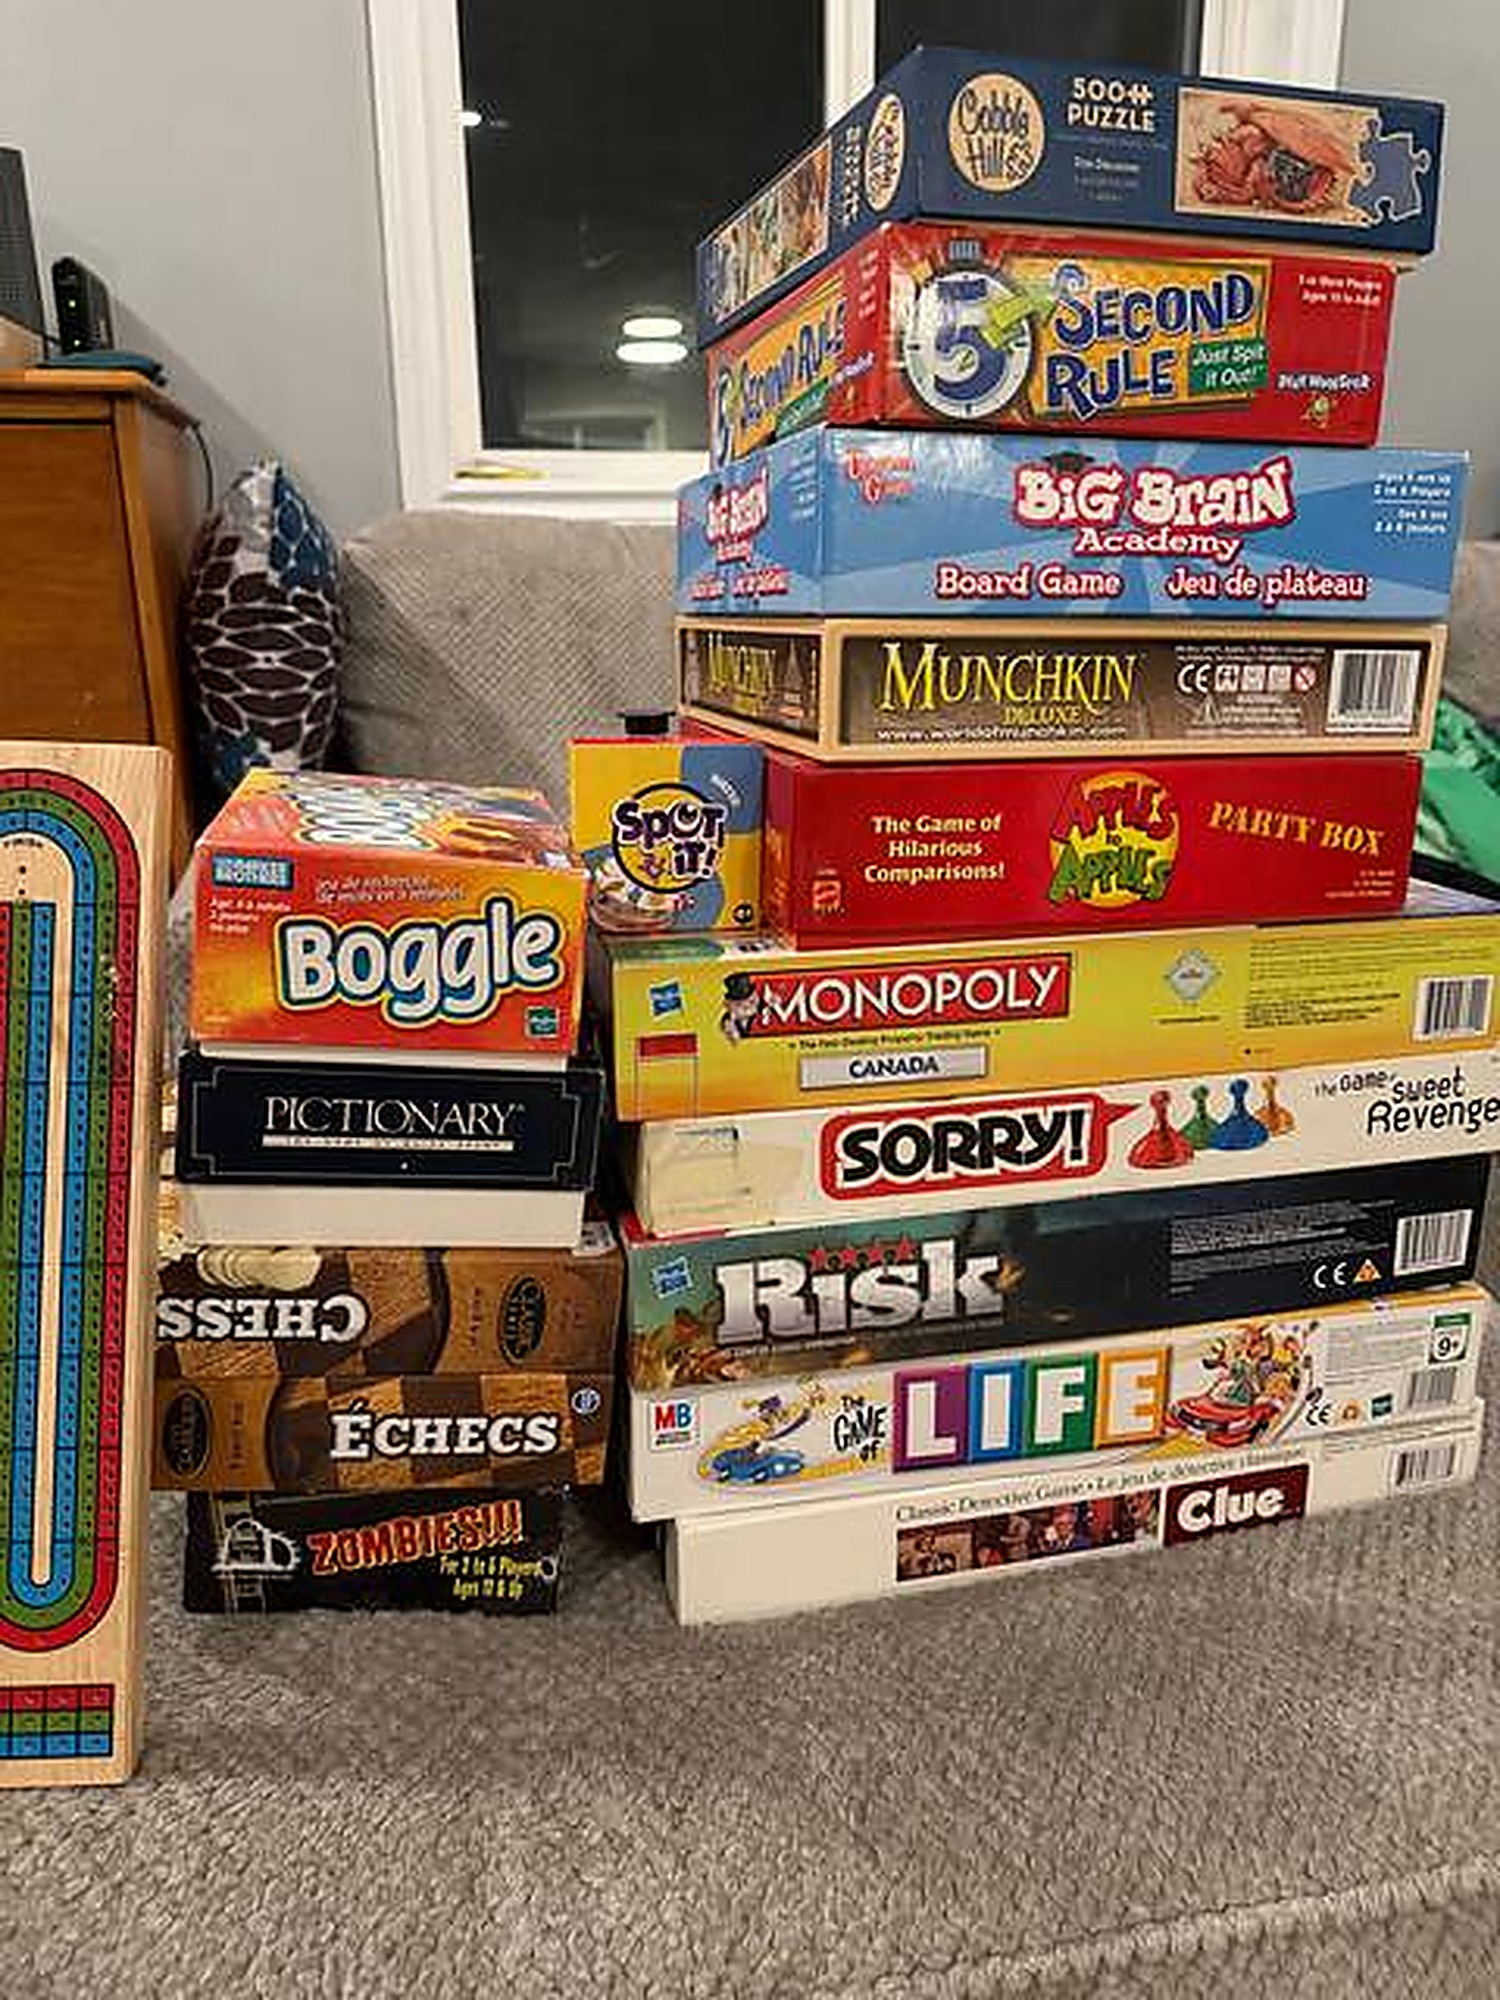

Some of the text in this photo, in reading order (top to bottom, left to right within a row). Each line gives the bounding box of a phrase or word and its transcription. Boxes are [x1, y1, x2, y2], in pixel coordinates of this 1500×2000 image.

[1072, 76, 1124, 101] 500
[1067, 103, 1157, 133] PUZZLE
[934, 278, 1006, 402] 5
[1051, 262, 1256, 350] SECOND
[1046, 350, 1178, 420] RULE
[1074, 526, 1243, 562] Academy
[936, 565, 1122, 597] Board Game
[1166, 566, 1366, 604] Jeu de plateau
[878, 641, 1138, 715] MUNCHKIN
[871, 813, 1002, 834] The Game of
[1208, 799, 1386, 858] PARTY BOX
[888, 839, 983, 858] Hilarious
[864, 861, 1006, 887] Comparisons!
[281, 899, 561, 1023] Boggle
[760, 964, 1060, 1026] MONOPOLY
[849, 1056, 939, 1079] CANADA
[1393, 1064, 1467, 1104] sweet
[264, 1096, 516, 1135] PICTIONARY
[1366, 1098, 1500, 1136] Revenge
[841, 1107, 1086, 1183] SORRY!
[156, 1293, 368, 1343] CHESS
[329, 1397, 559, 1460] ÉCHECS
[655, 1402, 693, 1431] MB
[906, 1361, 1160, 1459] LIFE
[1176, 1484, 1287, 1535] Clue
[306, 1498, 525, 1577] ZOMBIES!!!
